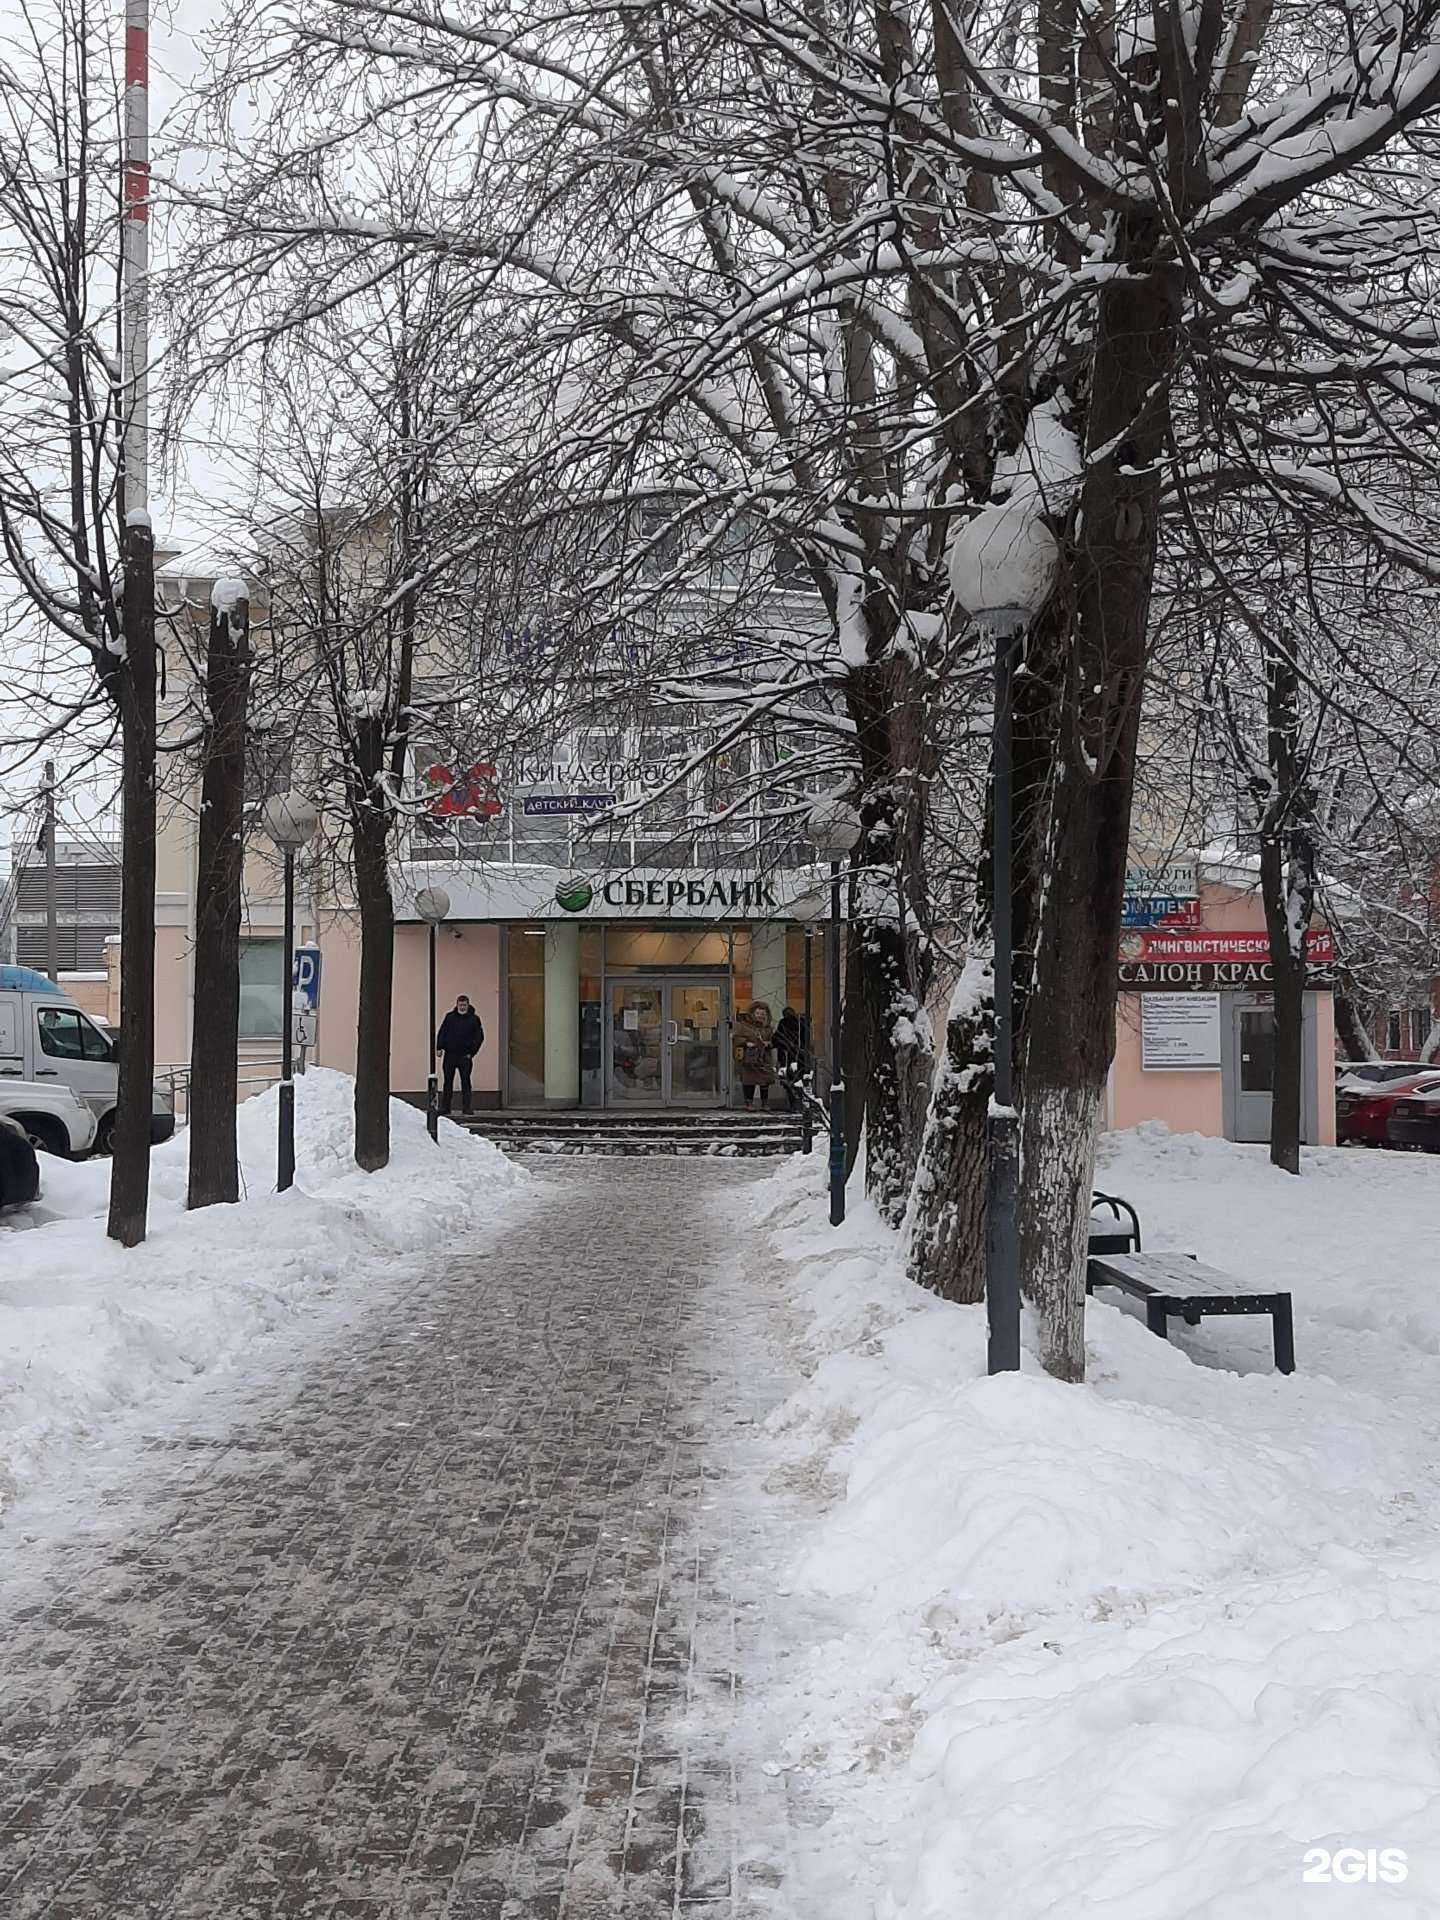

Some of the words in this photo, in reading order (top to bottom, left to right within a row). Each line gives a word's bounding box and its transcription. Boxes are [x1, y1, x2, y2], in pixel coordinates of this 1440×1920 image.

[603, 880, 778, 906] СБЕРБАНК
[297, 955, 314, 993] P
[1118, 963, 1201, 983] САЛОН
